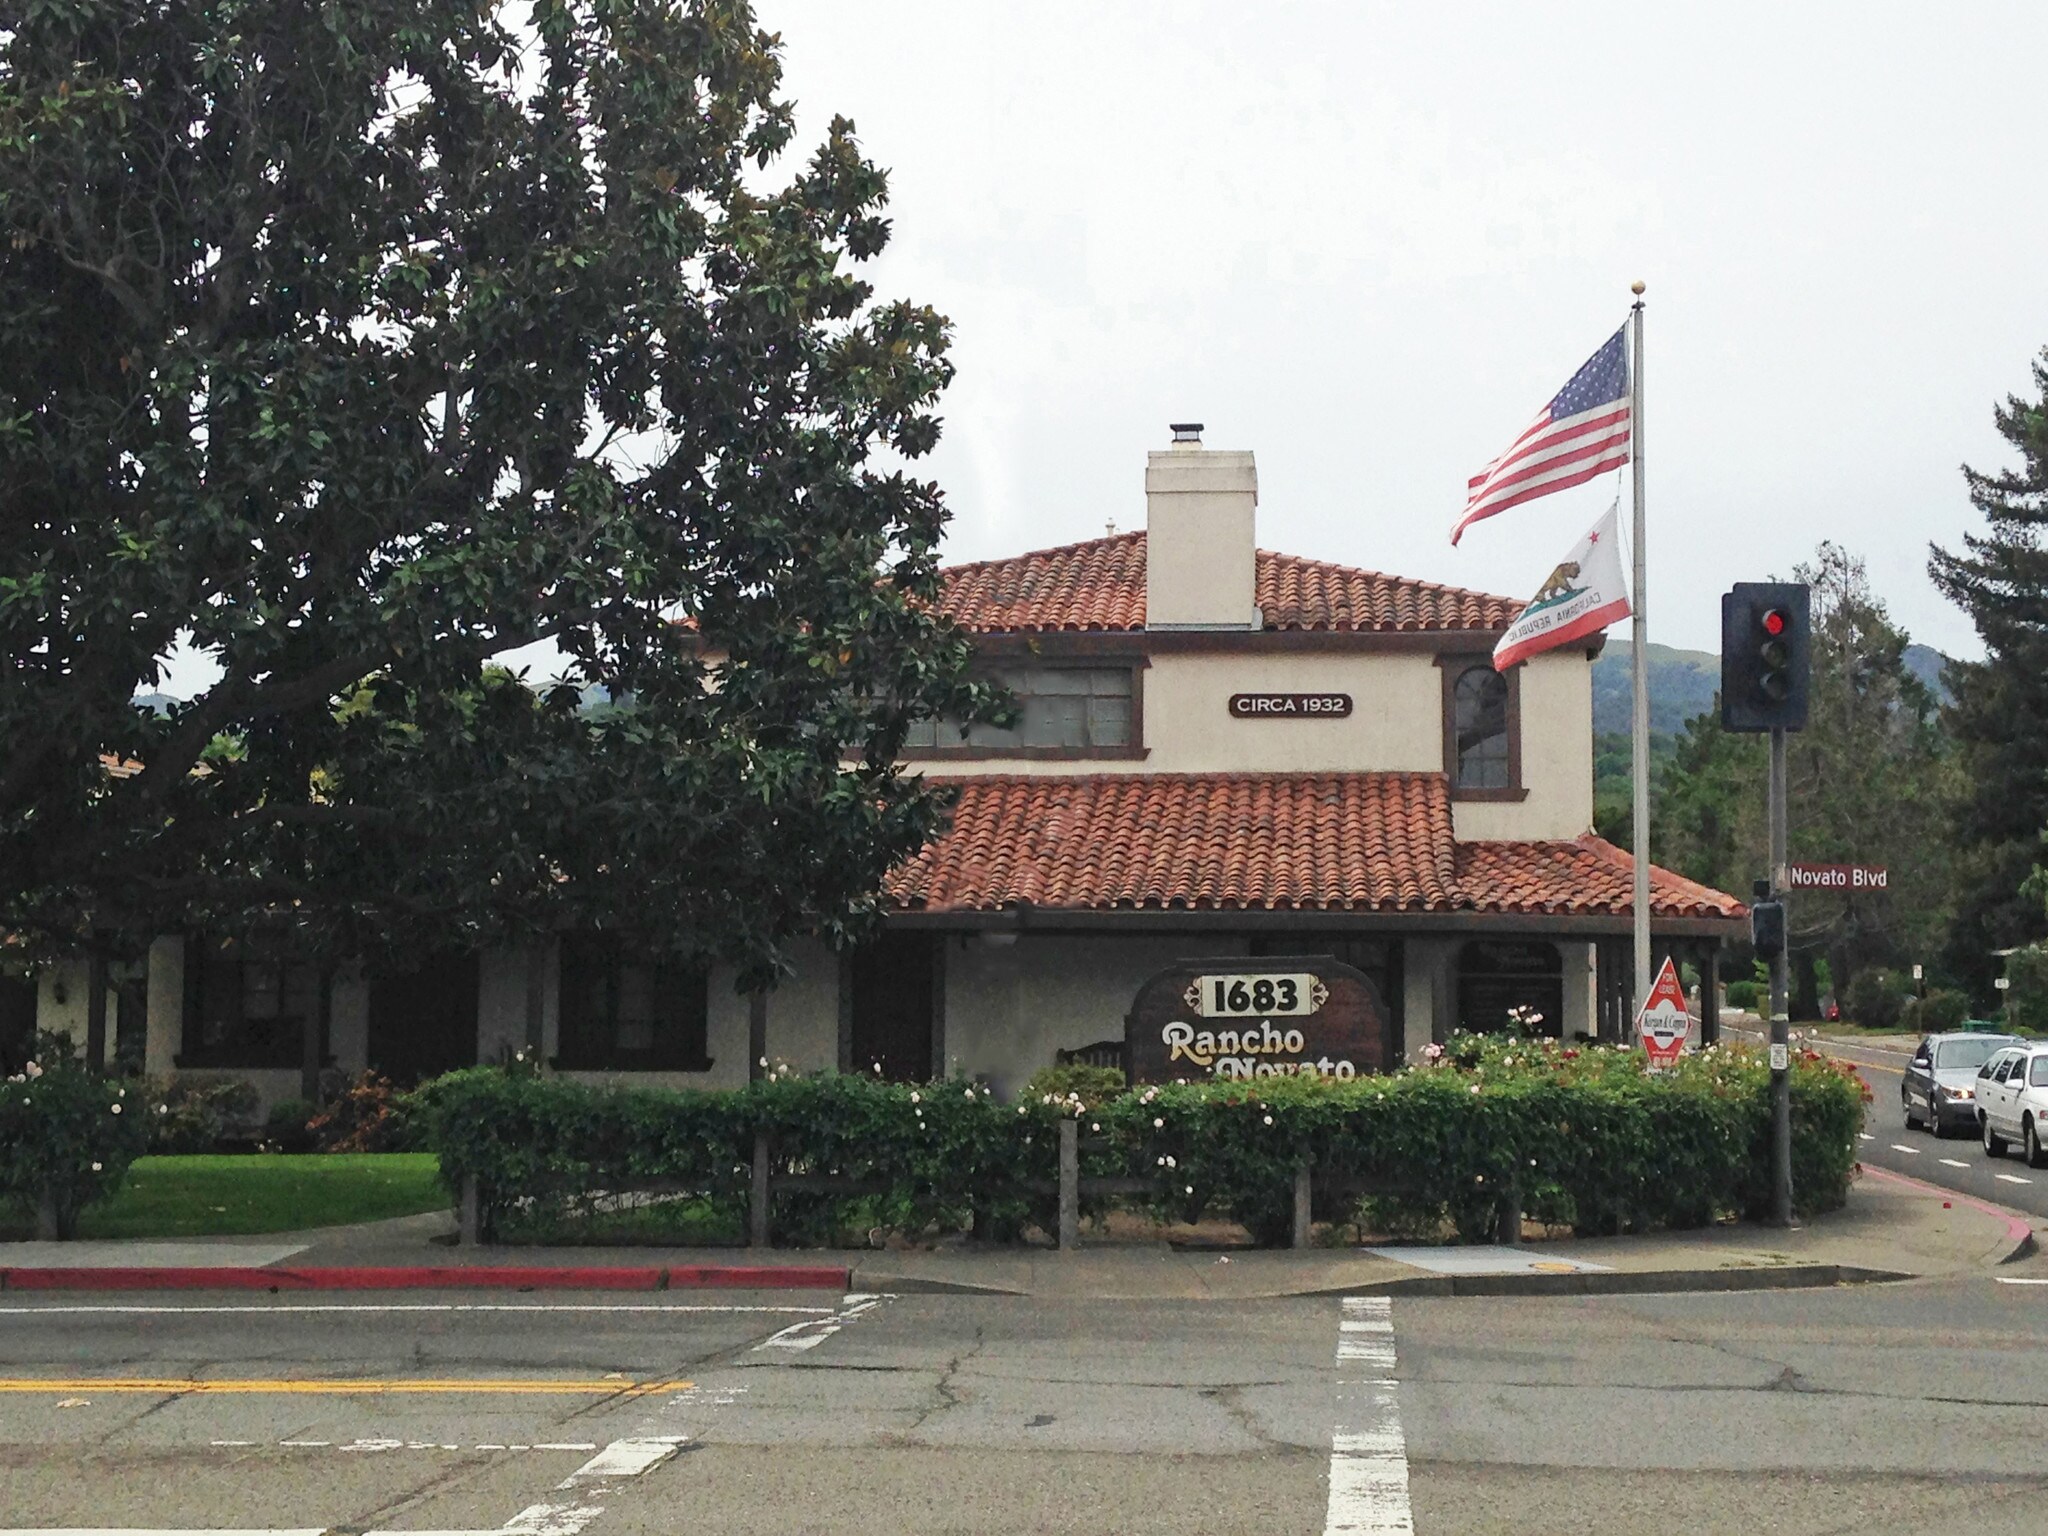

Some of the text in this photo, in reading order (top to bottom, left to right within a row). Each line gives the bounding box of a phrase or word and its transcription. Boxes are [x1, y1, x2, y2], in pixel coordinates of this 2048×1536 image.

[1237, 698, 1344, 712] CIRCA 1932
[1791, 867, 1887, 887] Novato Blvd
[1215, 979, 1298, 1012] 1683
[1162, 1020, 1304, 1066] Rancho
